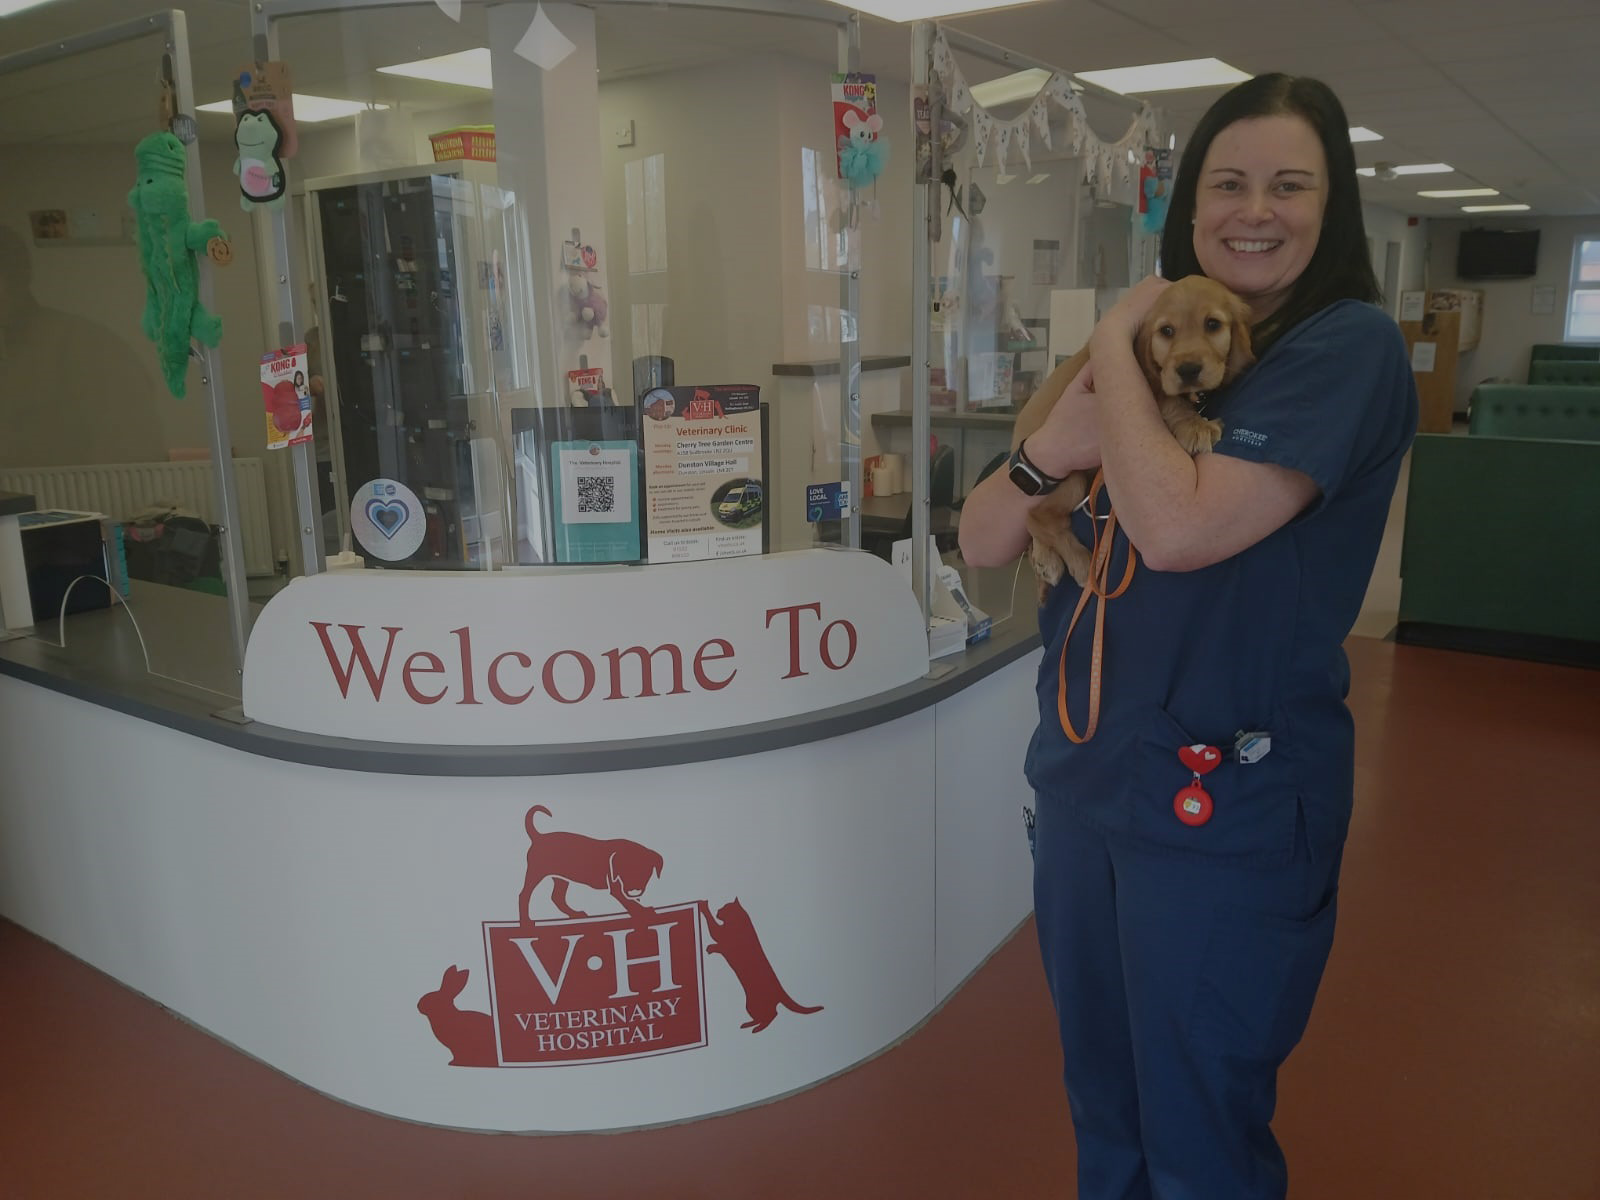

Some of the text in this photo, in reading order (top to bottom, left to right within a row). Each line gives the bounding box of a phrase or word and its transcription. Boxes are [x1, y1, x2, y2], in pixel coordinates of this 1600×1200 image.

[844, 85, 865, 96] KONG
[271, 358, 290, 374] KONG
[676, 426, 723, 436] Veterinary
[725, 425, 748, 433] Clinic
[677, 441, 697, 449] Cherry
[705, 459, 725, 467] Village
[810, 487, 824, 495] LOVE
[309, 602, 859, 706] Welcome To
[514, 998, 682, 1032] VETERINARY
[537, 1024, 664, 1053] HOSPITAL
